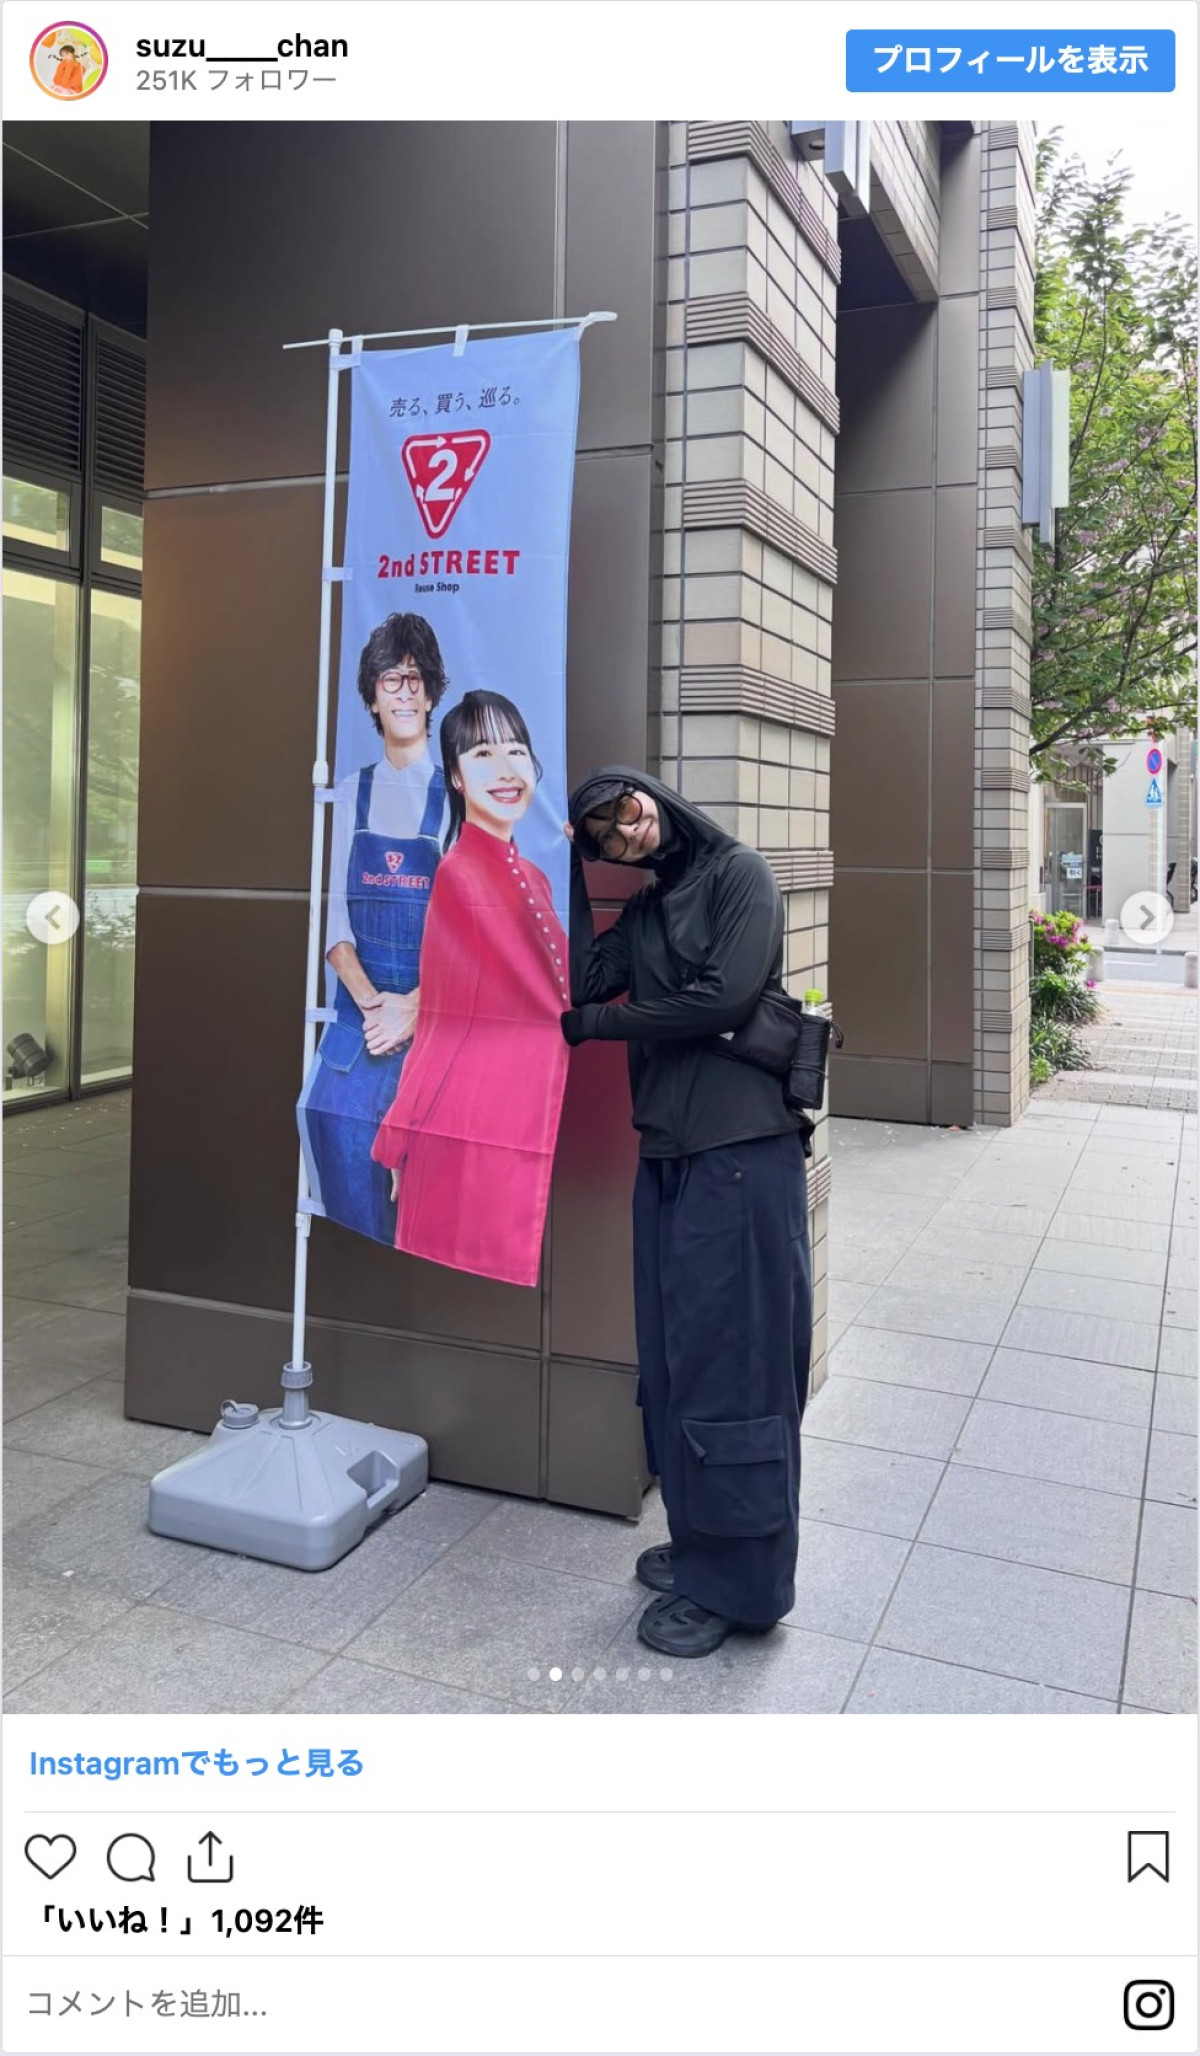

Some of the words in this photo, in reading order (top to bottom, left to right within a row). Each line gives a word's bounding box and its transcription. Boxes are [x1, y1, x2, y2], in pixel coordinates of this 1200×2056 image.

[389, 386, 521, 418] 売る、買う、巡る。
[426, 449, 459, 503] 2
[377, 554, 416, 579] 2nd
[419, 550, 521, 576] STREET
[437, 581, 460, 594] Shop
[362, 871, 383, 885] 2nd
[384, 874, 430, 889] STREET
